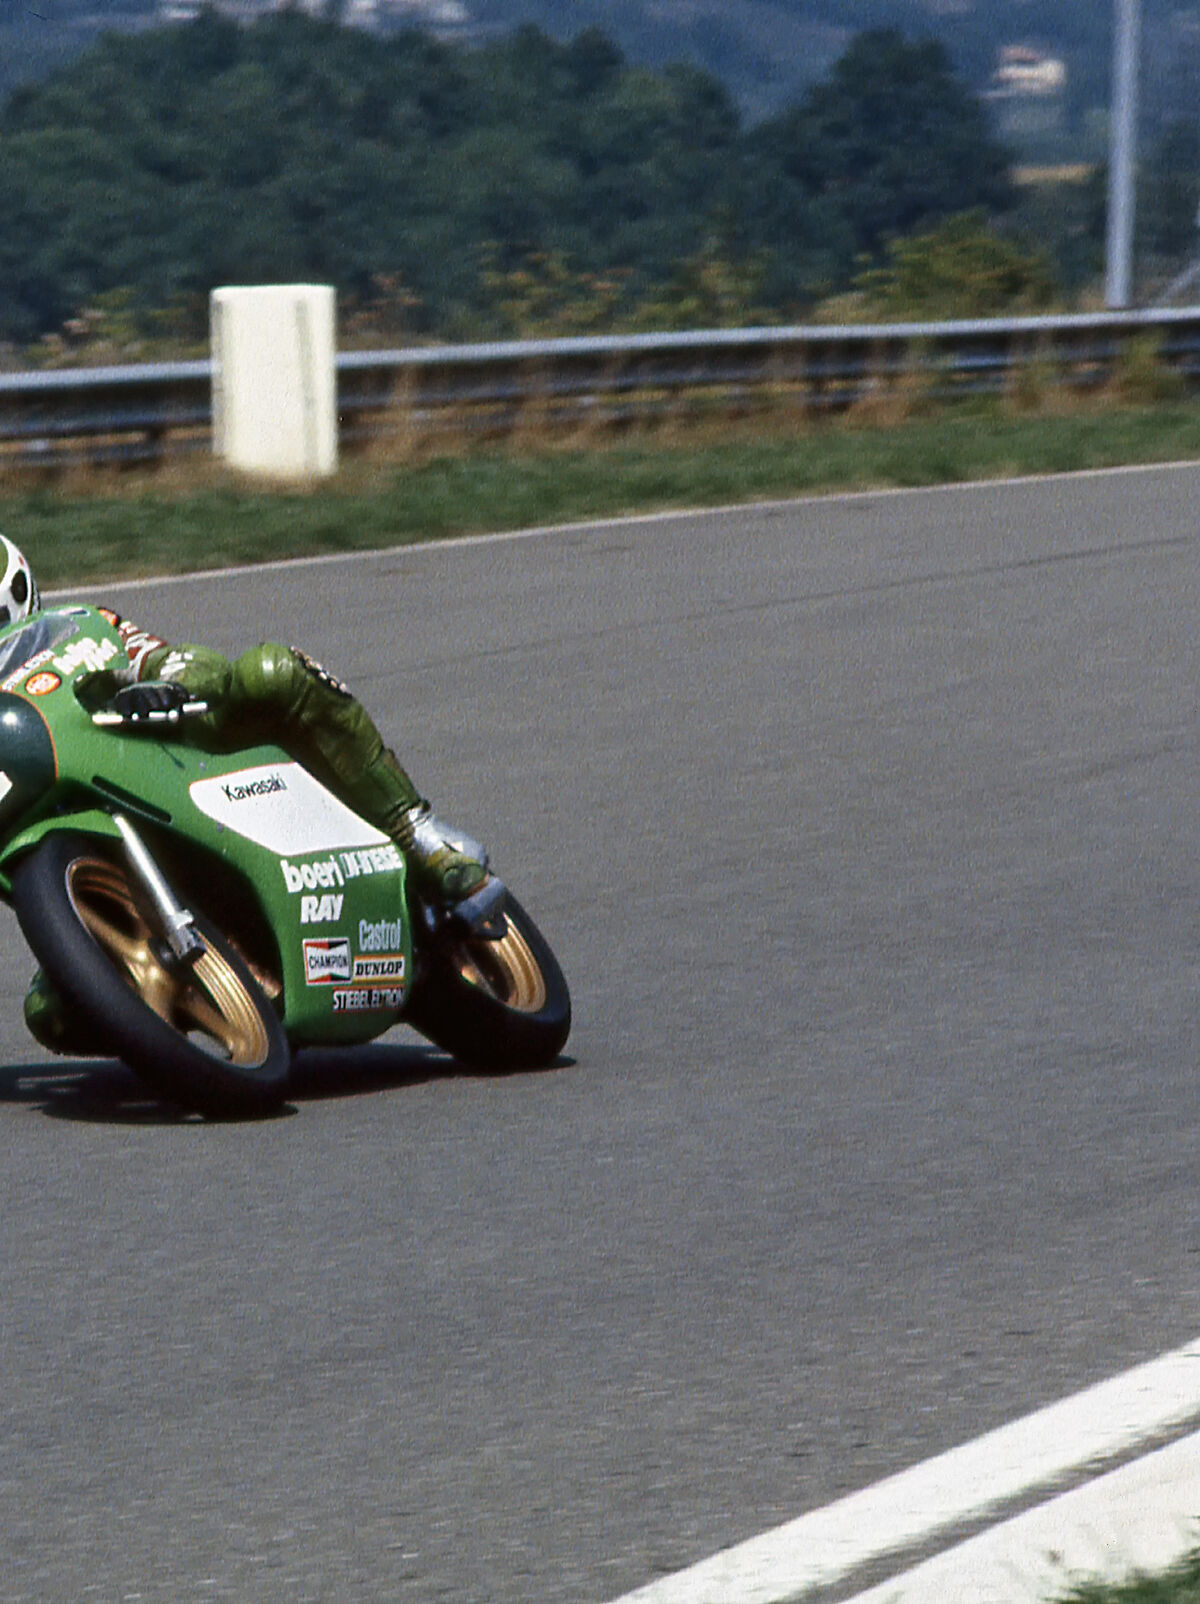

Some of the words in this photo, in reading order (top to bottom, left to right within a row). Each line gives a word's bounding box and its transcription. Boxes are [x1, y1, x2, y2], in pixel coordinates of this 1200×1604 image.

[221, 772, 288, 802] Kawasaki
[280, 855, 345, 893] boeri
[300, 893, 344, 924] RAY
[358, 917, 402, 952] Castrol
[308, 951, 349, 970] CHAMPION
[355, 961, 403, 976] DUNLOP
